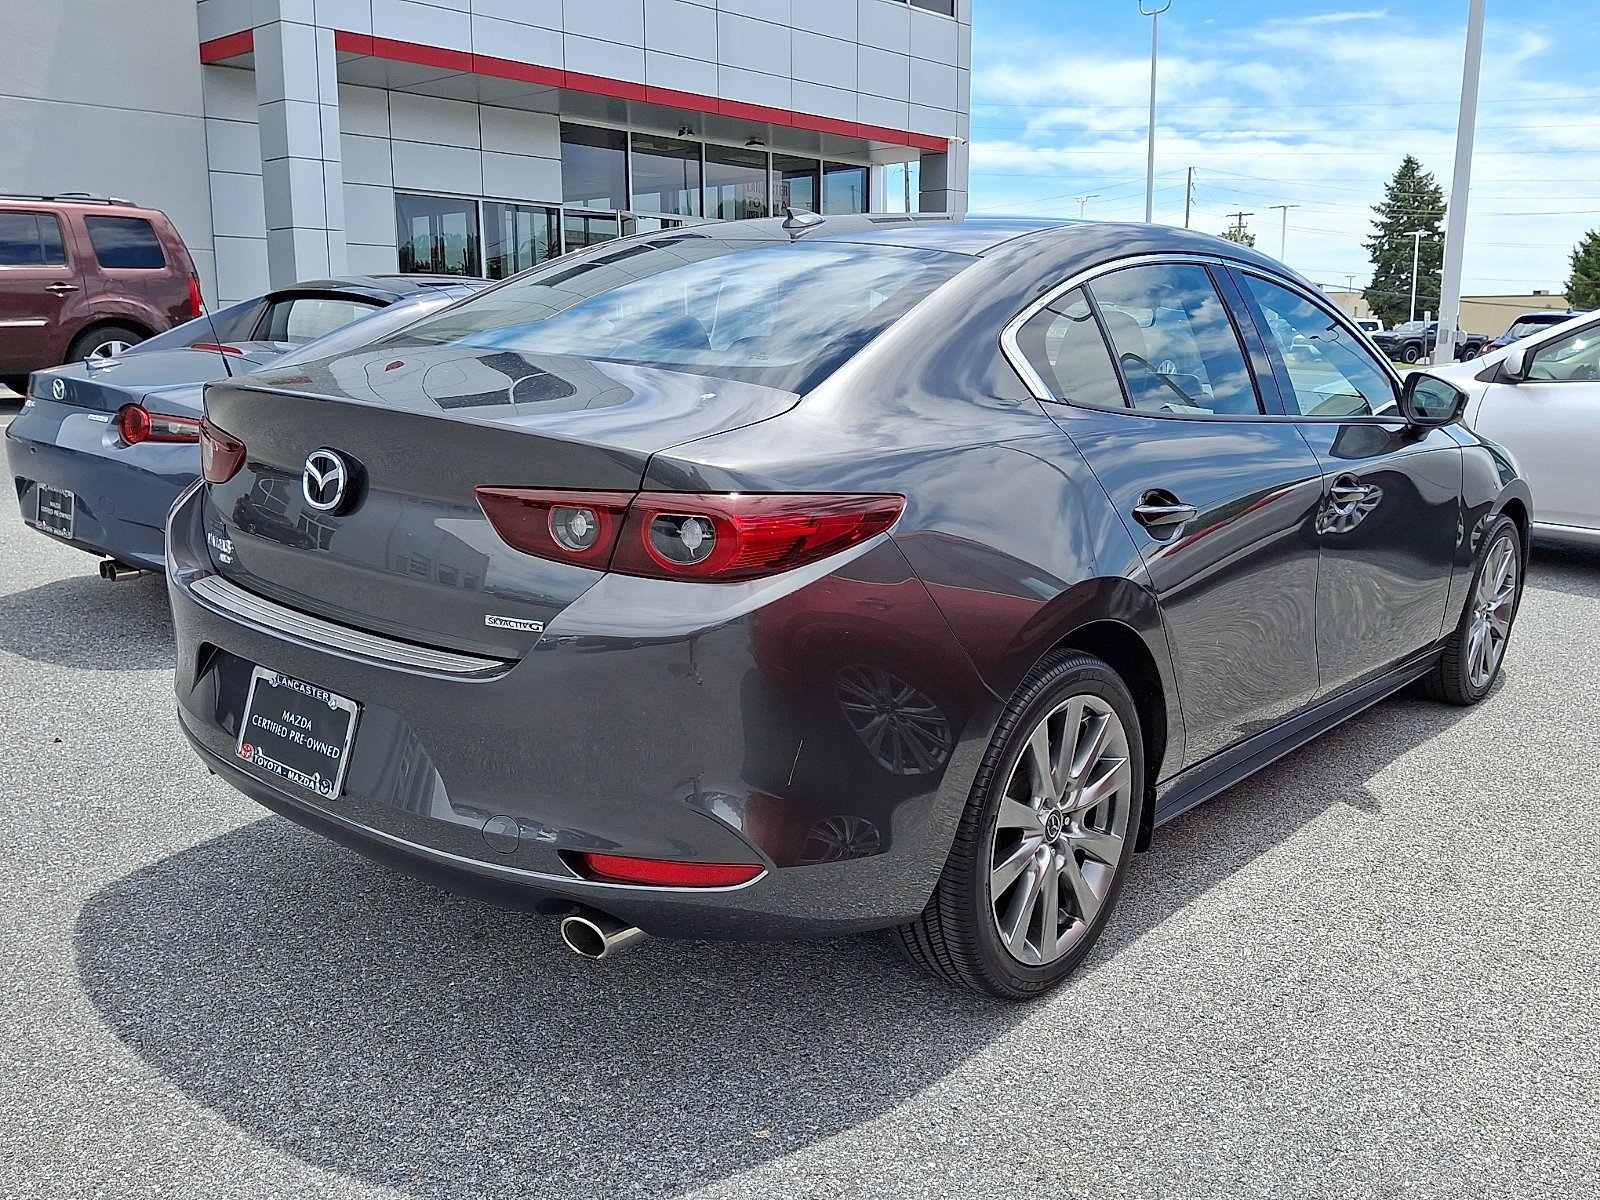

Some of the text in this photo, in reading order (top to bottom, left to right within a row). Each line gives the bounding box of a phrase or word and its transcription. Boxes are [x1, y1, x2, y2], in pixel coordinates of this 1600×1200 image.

[277, 674, 329, 701] LANCASTER
[251, 714, 341, 759] CERTIFIED PRE-OWNED
[281, 710, 313, 732] MAZDA
[253, 754, 282, 775] TOYOTA
[287, 770, 315, 790] MAZDA
